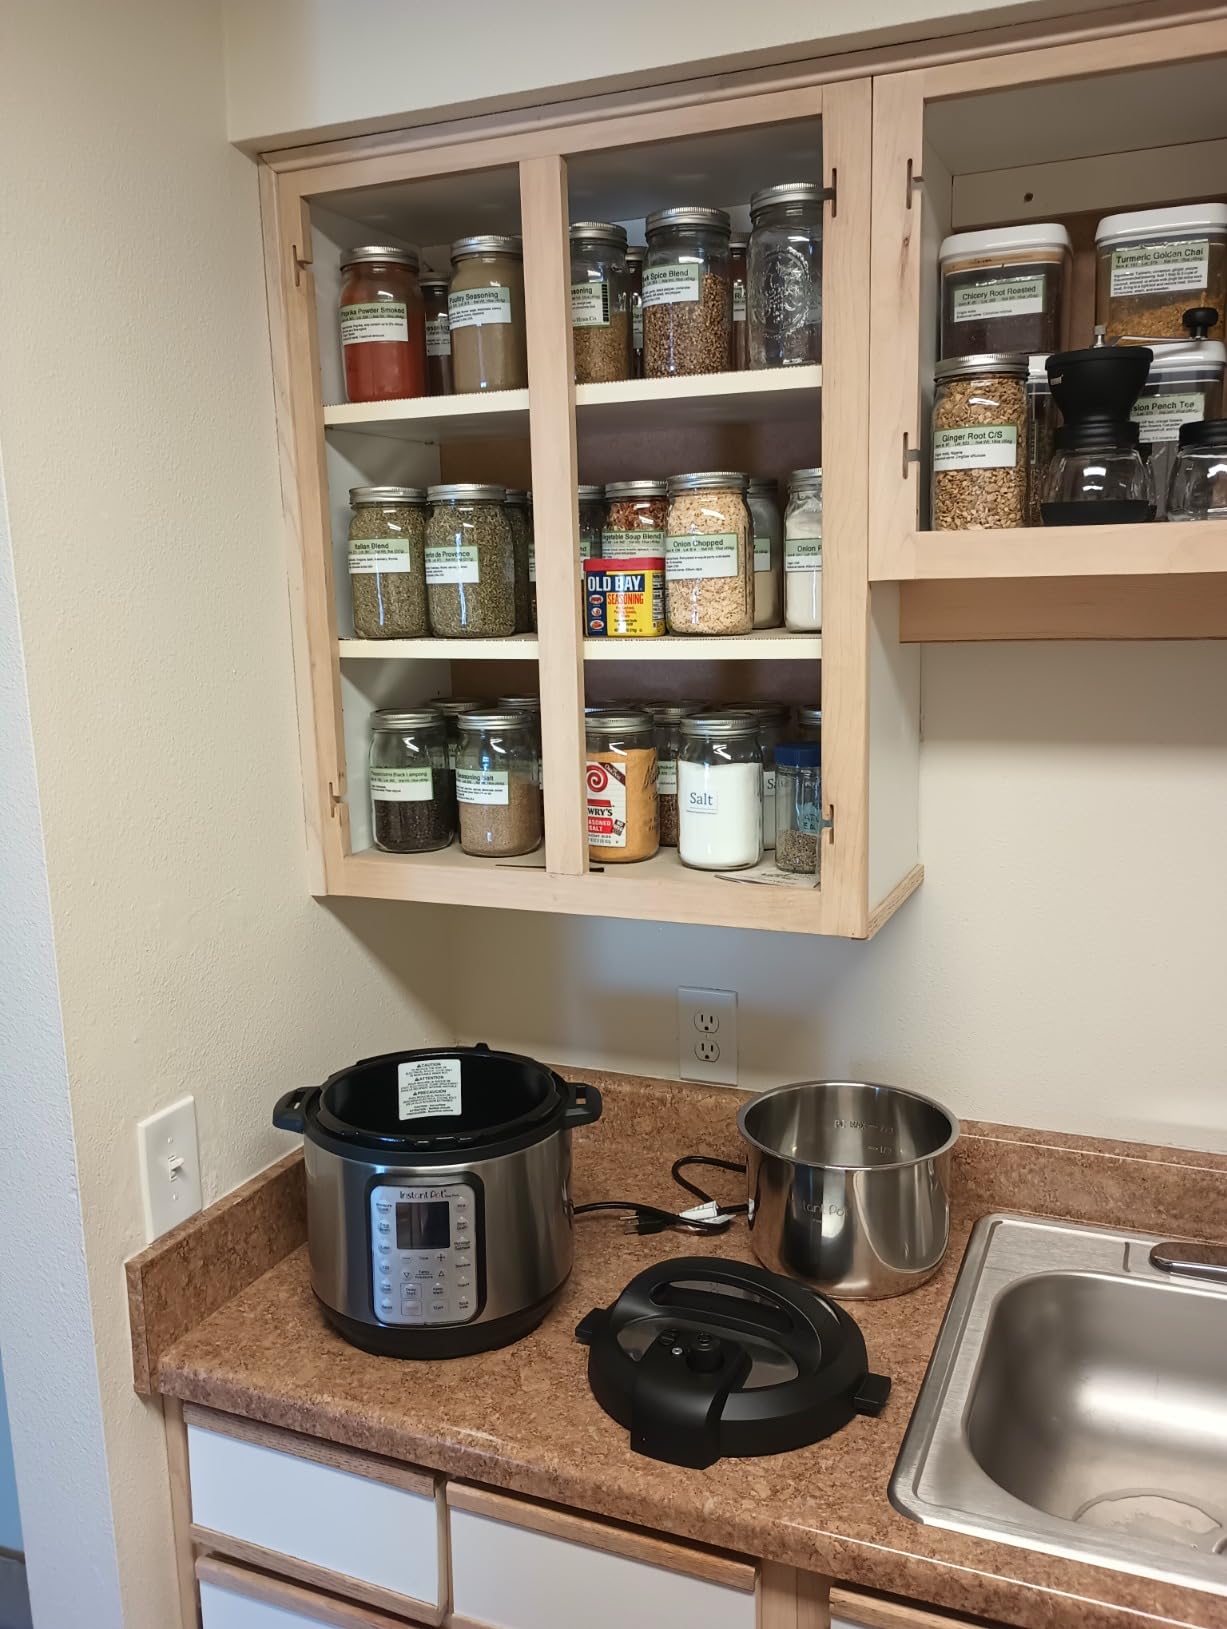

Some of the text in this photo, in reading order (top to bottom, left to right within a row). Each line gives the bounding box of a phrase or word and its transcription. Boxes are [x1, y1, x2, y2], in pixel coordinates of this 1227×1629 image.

[1116, 252, 1151, 263] Turmeric
[1153, 250, 1182, 260] Golden
[1184, 248, 1203, 257] Chai
[650, 271, 667, 281] Spice
[669, 268, 689, 278] Blend
[465, 291, 499, 300] Seasoning
[962, 291, 988, 301] Chicory
[989, 289, 1005, 297] Root
[1007, 285, 1036, 295] Roasted
[358, 306, 379, 315] Powder
[380, 306, 405, 315] Smoked
[1133, 402, 1150, 412] sion
[942, 430, 1003, 443] Ginger Root C/S
[624, 532, 642, 541] Soup
[642, 532, 662, 540] Blend
[673, 538, 724, 548] Onion Chopped
[797, 544, 816, 552] Onion
[587, 575, 641, 592] OLD BAY
[607, 593, 644, 605] SEASONING
[689, 791, 713, 806] Salt
[587, 807, 613, 817] WRY'S
[399, 1189, 445, 1200] Instant Pot
